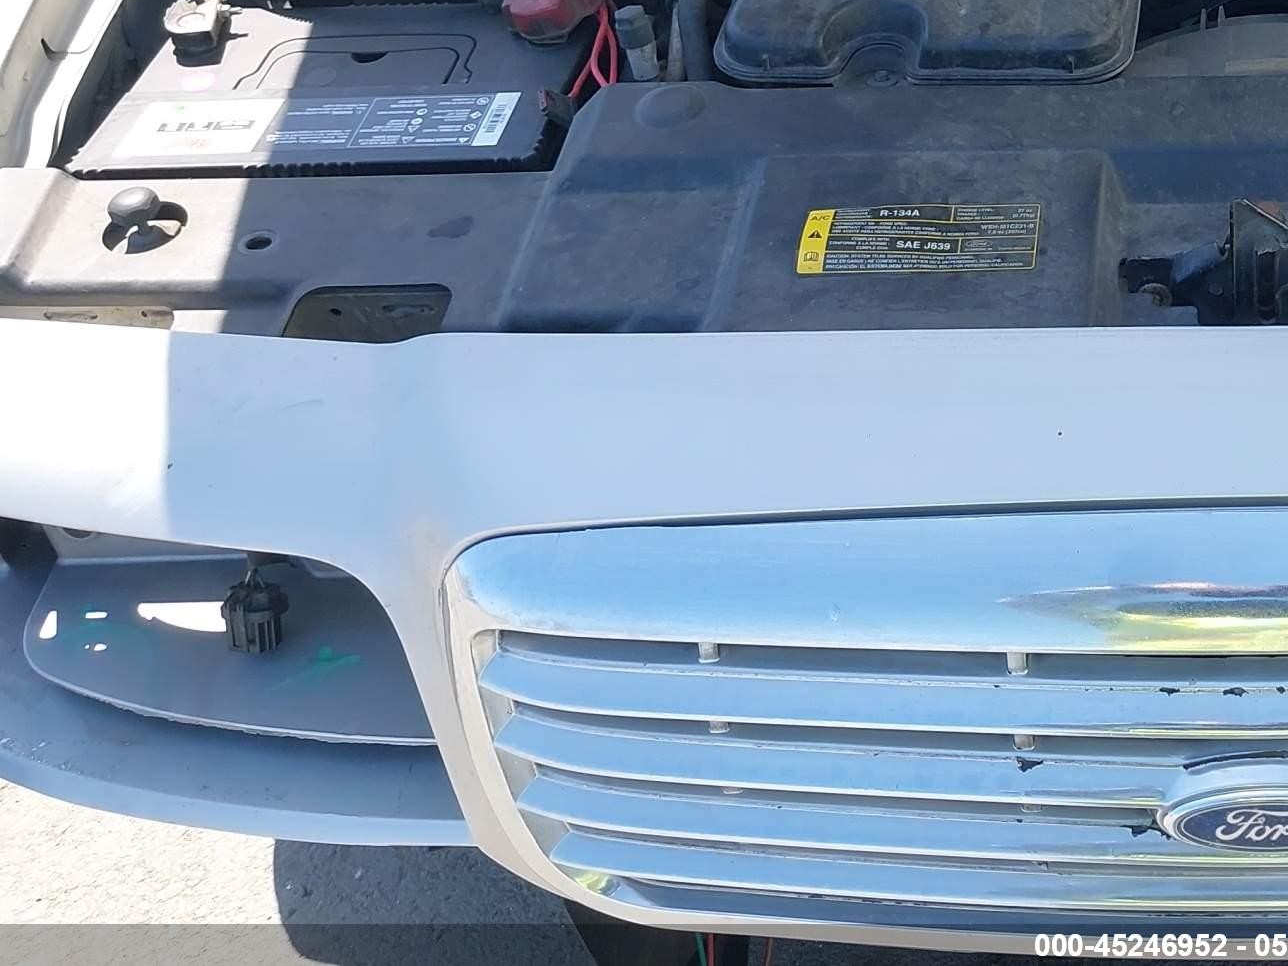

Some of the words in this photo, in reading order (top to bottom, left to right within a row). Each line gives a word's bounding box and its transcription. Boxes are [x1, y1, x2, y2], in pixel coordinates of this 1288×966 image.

[880, 209, 920, 217] R-134A
[896, 240, 921, 249] SAE
[923, 241, 951, 250] J639
